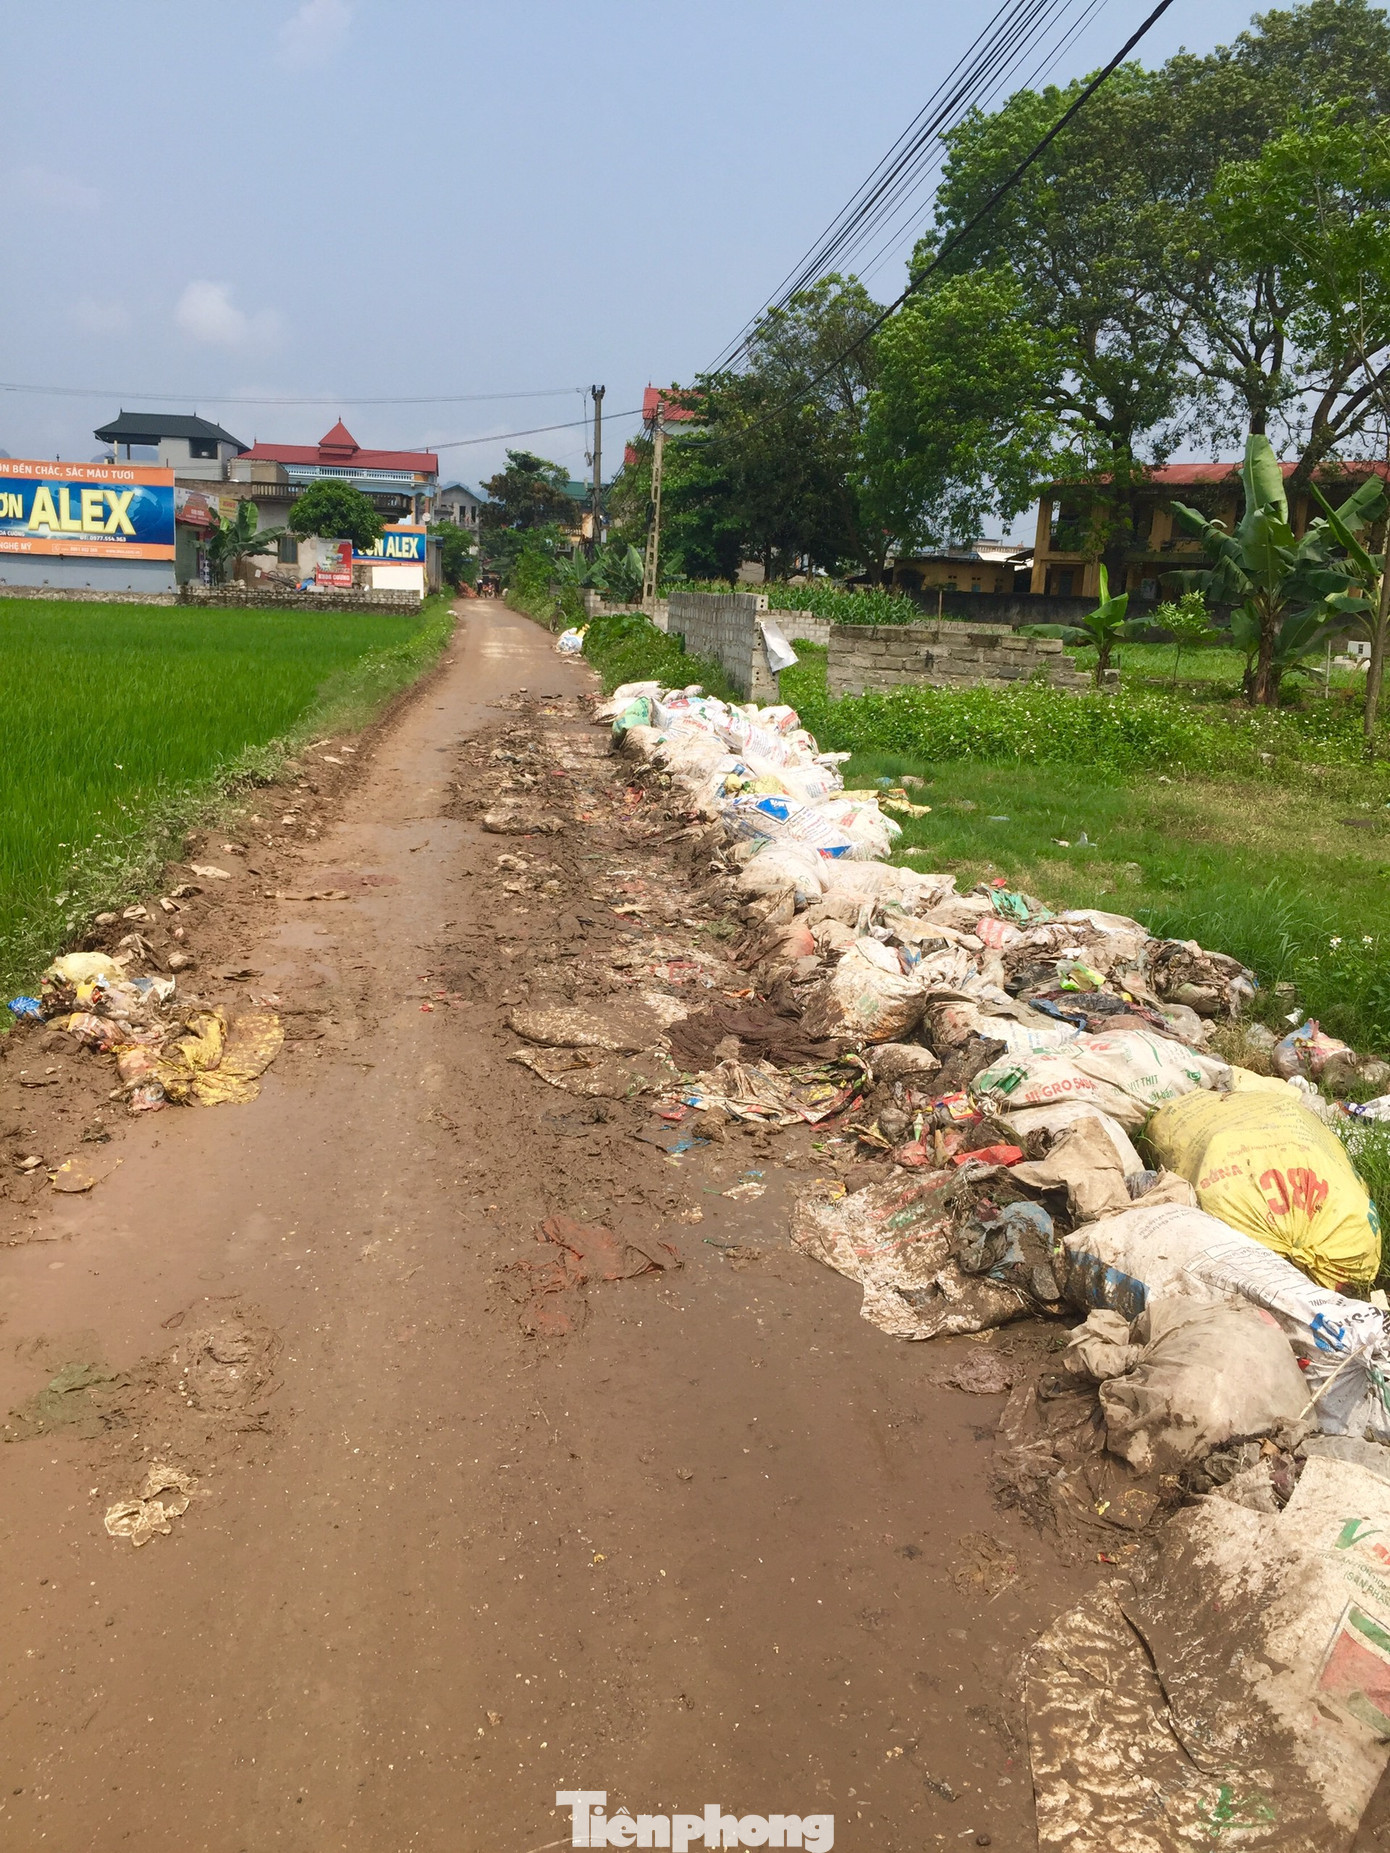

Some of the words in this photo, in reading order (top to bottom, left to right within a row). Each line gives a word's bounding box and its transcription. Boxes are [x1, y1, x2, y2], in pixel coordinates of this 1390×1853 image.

[111, 470, 134, 480] TƯƠI
[28, 486, 137, 536] ALEX
[386, 536, 419, 559] ALEX
[1042, 1079, 1072, 1097] GRO
